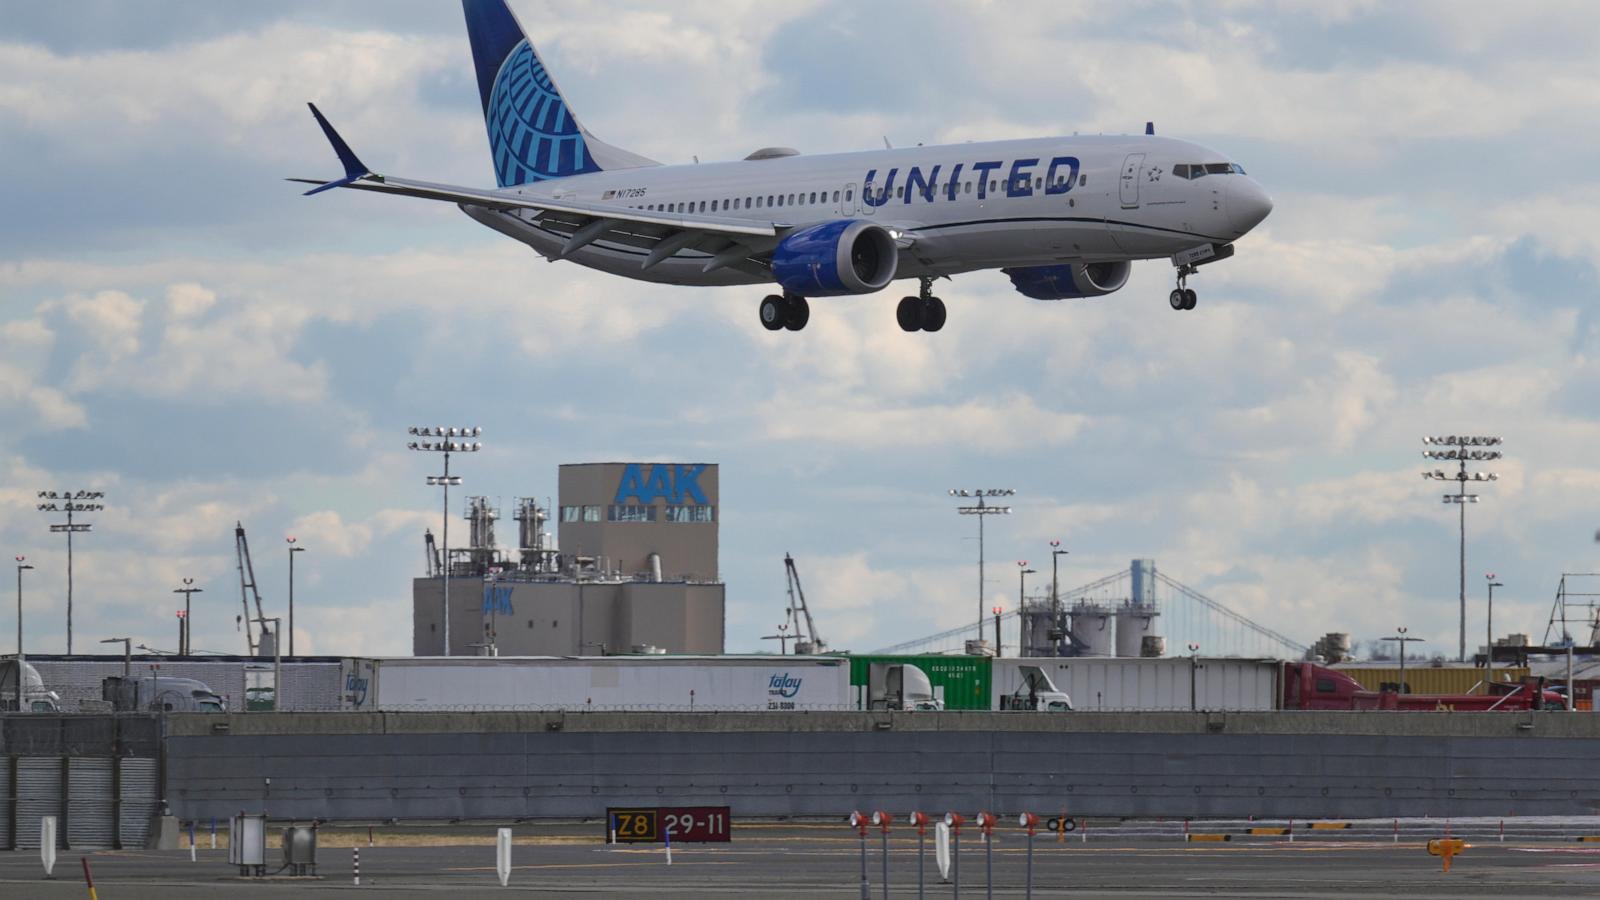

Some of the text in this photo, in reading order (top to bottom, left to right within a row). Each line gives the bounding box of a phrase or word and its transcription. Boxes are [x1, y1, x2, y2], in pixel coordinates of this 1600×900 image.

[615, 187, 647, 199] N17285
[862, 156, 1080, 207] UNITED
[614, 463, 709, 505] AAK
[482, 586, 513, 616] AAK
[618, 813, 723, 835] Z8 29-11
